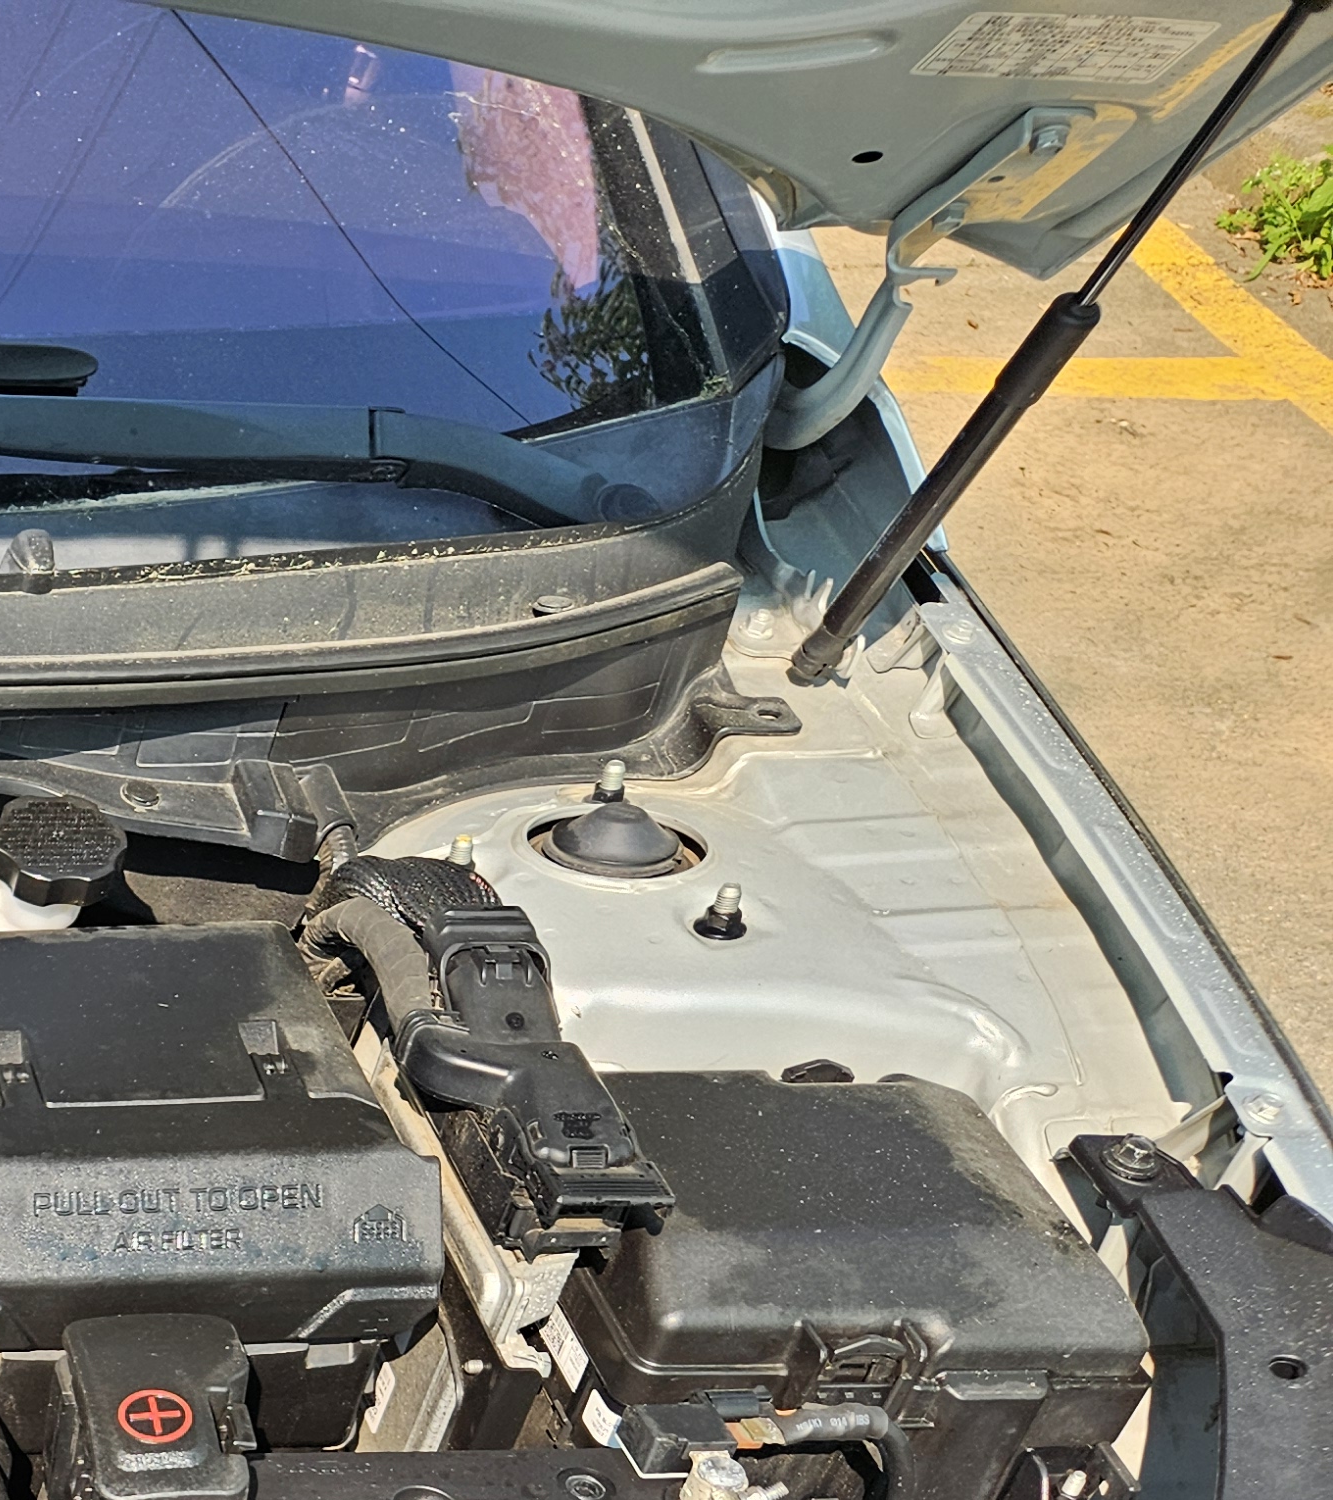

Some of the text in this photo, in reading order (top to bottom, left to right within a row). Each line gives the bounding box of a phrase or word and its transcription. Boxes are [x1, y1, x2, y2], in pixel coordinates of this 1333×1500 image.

[32, 1183, 323, 1217] PULL OUT TO OPEN
[111, 1228, 243, 1253] AIR FILTER
